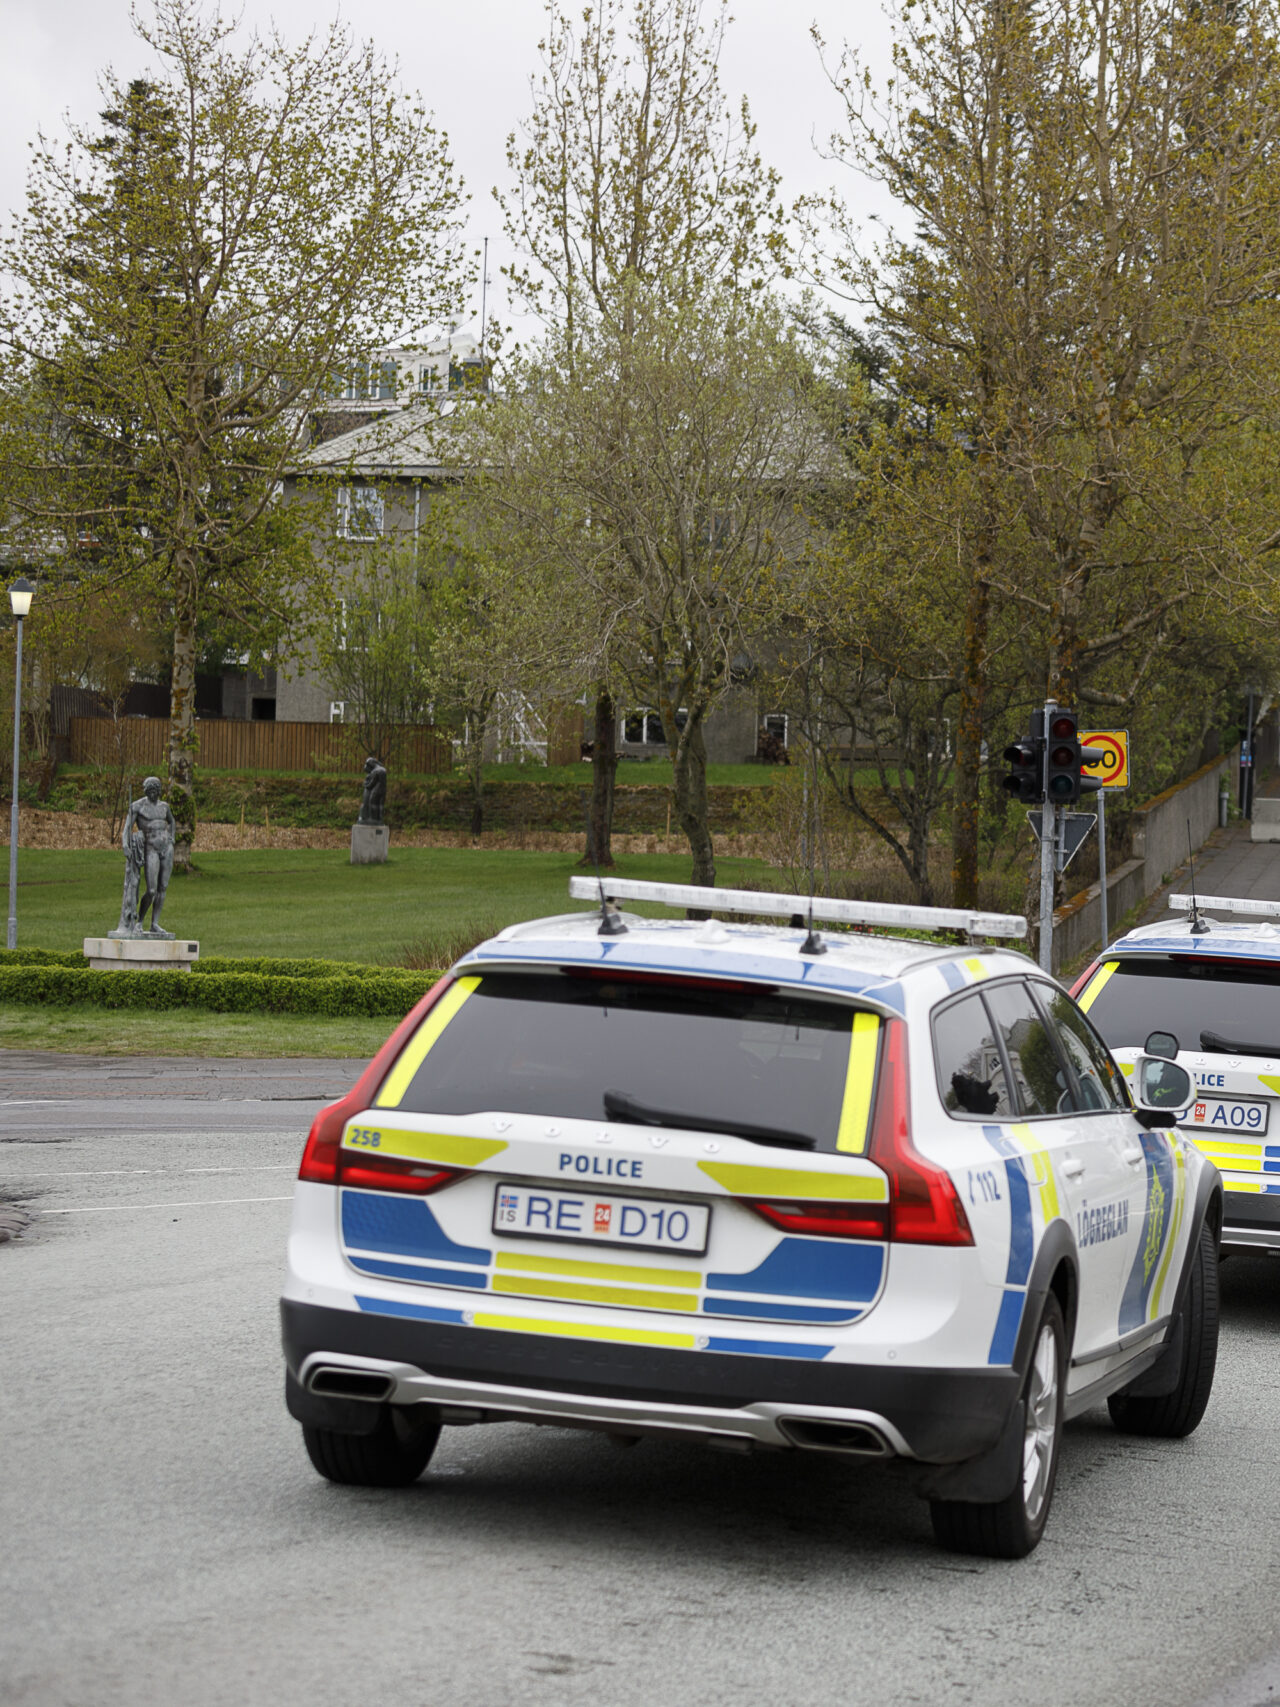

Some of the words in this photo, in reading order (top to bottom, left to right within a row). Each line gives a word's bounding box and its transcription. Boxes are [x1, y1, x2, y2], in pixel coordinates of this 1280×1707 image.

[1193, 1072, 1225, 1087] LICE
[1195, 1105, 1206, 1116] 24
[1211, 1104, 1262, 1128] A09
[350, 1128, 381, 1148] 258
[492, 1120, 721, 1154] VOLVO
[558, 1152, 643, 1179] POLICE
[976, 1169, 1002, 1202] 112
[500, 1208, 517, 1223] IS
[525, 1195, 585, 1233] RE
[594, 1207, 610, 1223] 24
[618, 1205, 690, 1243] D10
[1076, 1199, 1129, 1249] LÖGREGLAN
